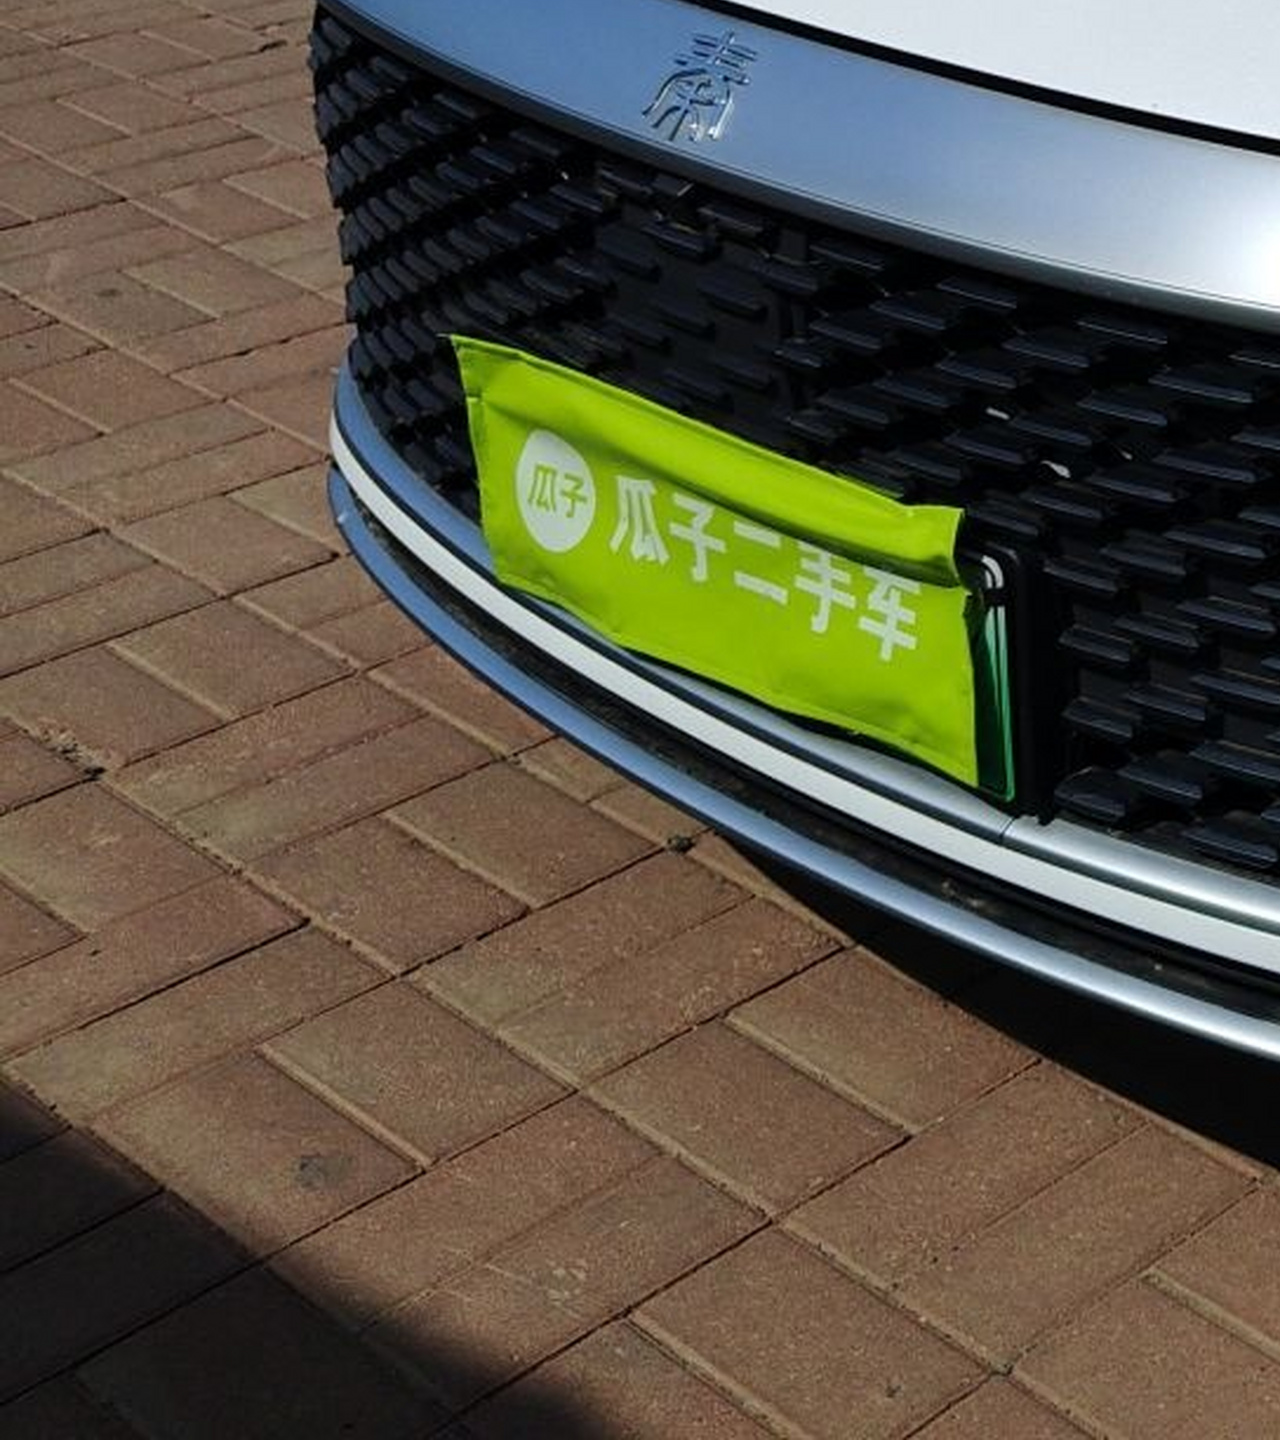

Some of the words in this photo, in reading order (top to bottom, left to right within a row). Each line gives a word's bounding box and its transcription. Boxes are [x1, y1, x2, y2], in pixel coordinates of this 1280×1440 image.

[528, 463, 588, 519] 瓜子
[609, 474, 921, 662] 瓜子二手车
